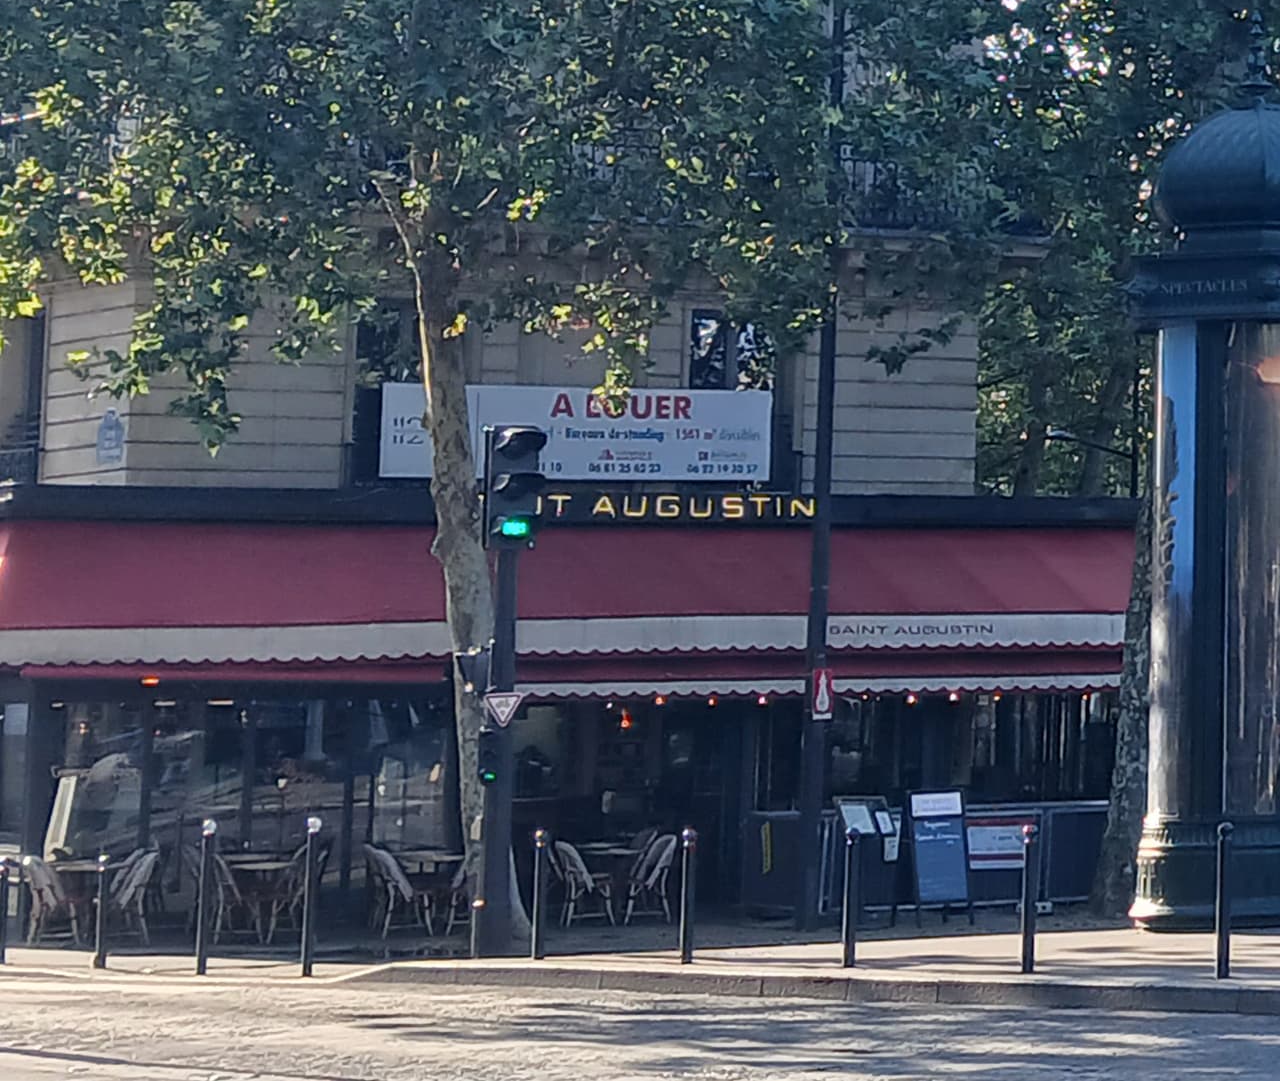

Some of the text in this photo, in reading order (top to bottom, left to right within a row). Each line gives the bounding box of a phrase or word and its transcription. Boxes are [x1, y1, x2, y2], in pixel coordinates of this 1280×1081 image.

[1160, 279, 1248, 295] SPECTACLES
[550, 394, 575, 418] A
[591, 495, 816, 518] AUGUSTIN
[829, 624, 994, 635] SAINT AUGUSTIN
